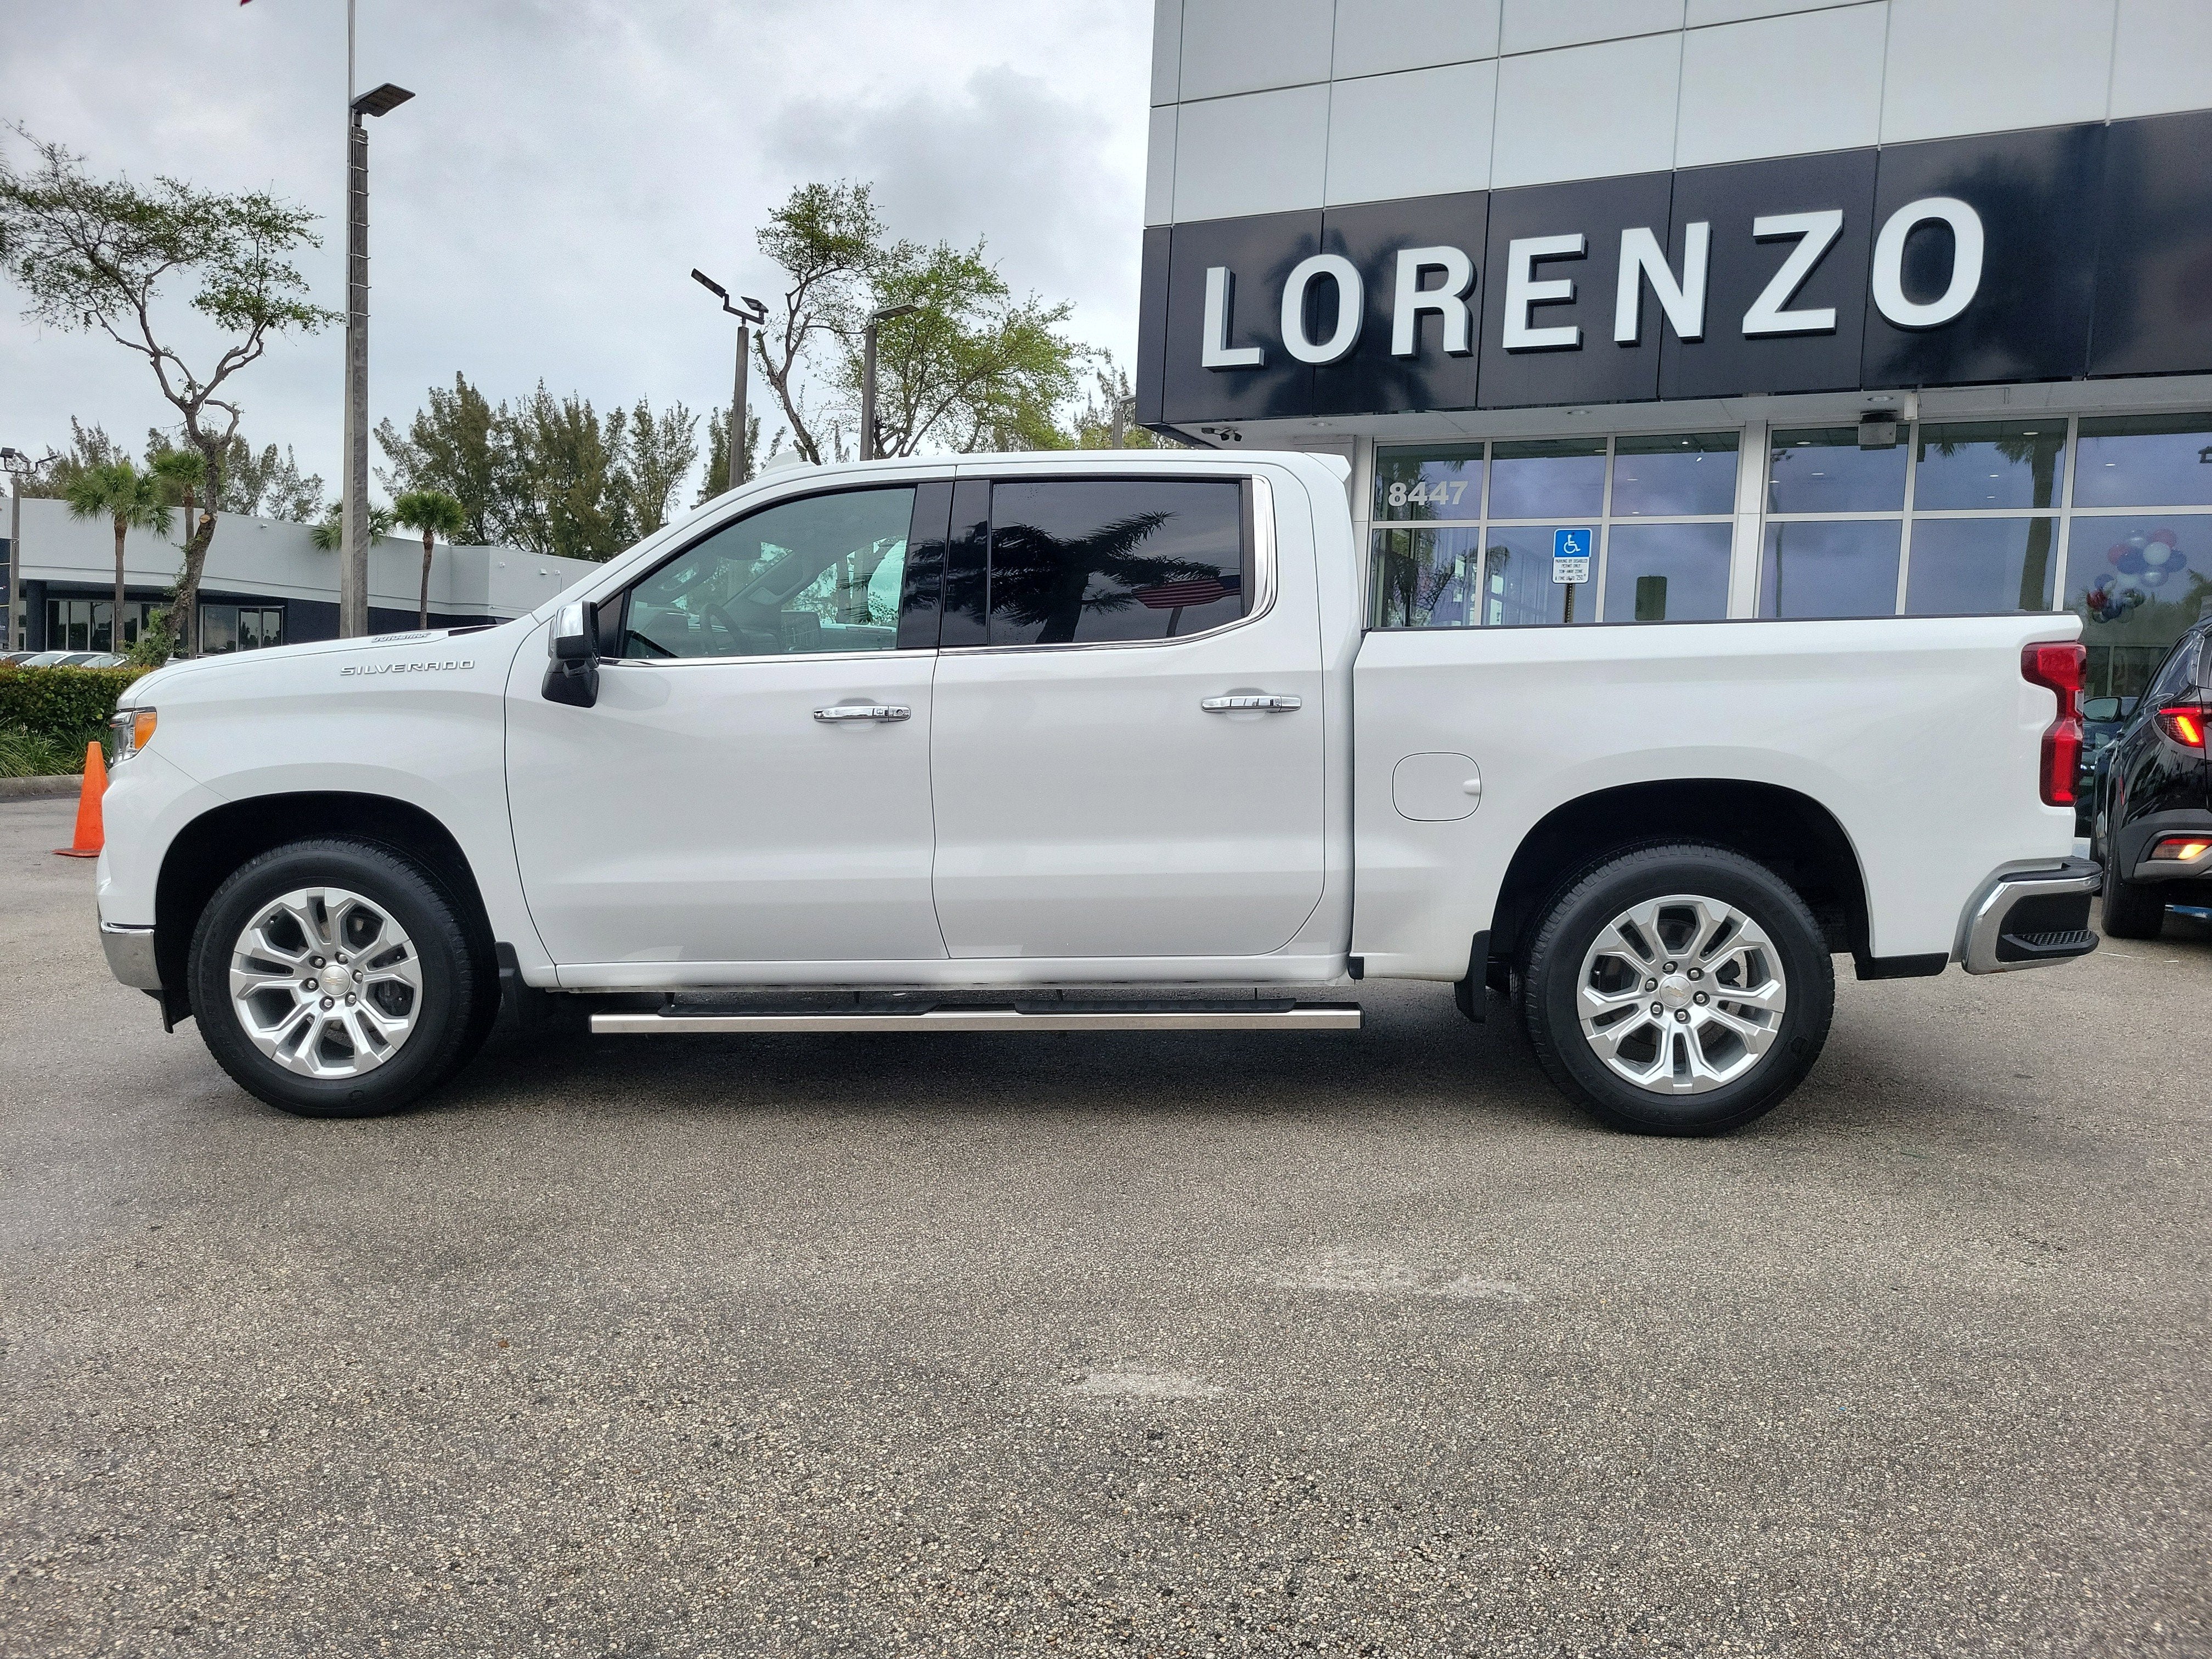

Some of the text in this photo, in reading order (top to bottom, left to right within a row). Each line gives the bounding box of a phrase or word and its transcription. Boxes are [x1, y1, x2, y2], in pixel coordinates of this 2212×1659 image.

[1201, 196, 1985, 369] LORENZO
[1388, 481, 1468, 506] 8447
[340, 660, 475, 676] SILVERADO
